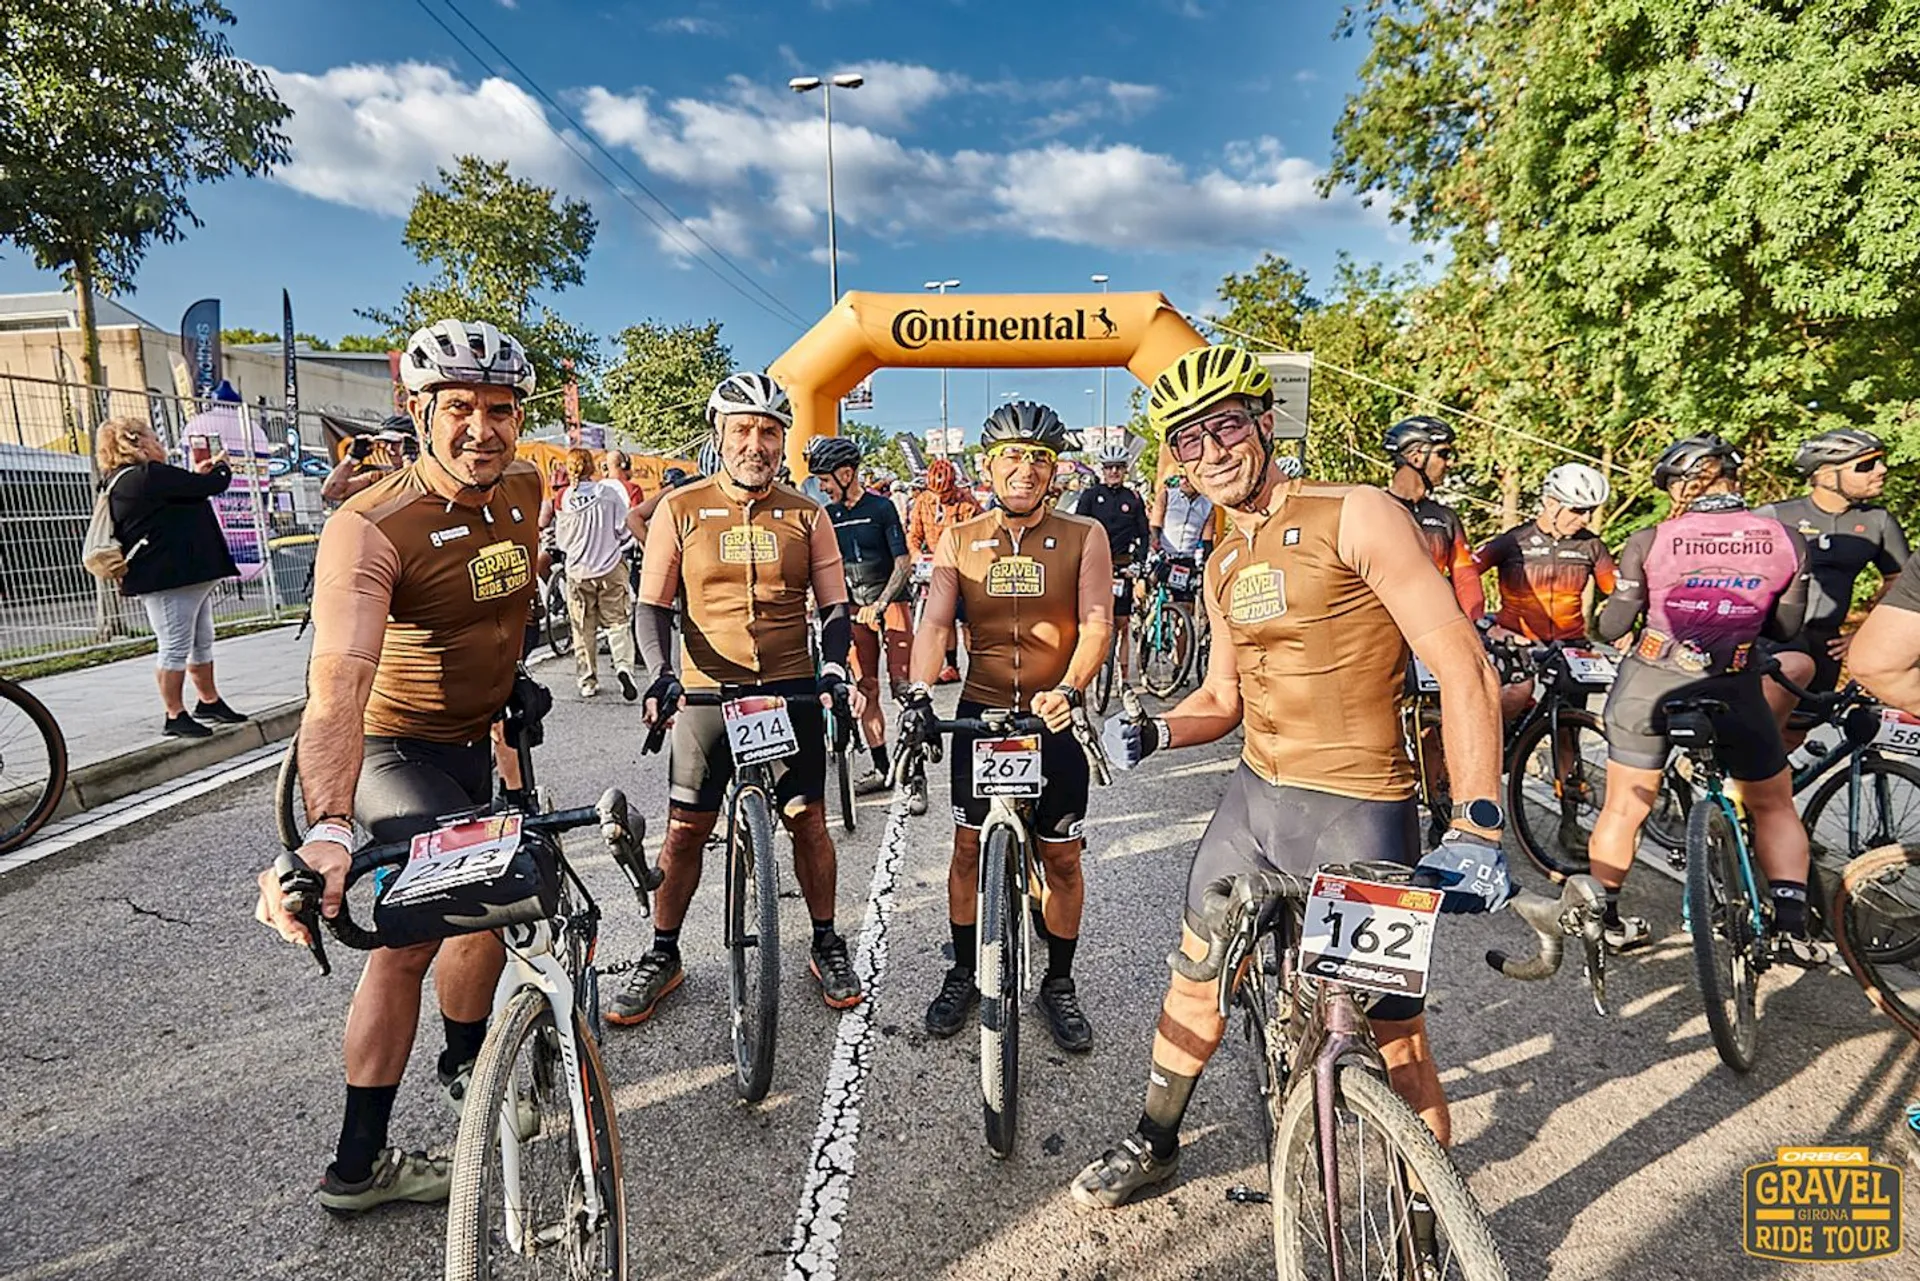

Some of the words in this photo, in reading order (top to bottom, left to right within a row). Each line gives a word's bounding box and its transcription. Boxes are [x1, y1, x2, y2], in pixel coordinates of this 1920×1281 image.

[892, 309, 1086, 349] Continental
[724, 532, 773, 546] GRAVEL
[1672, 537, 1774, 555] PINOCCHIO
[475, 550, 526, 578] GRAVEL
[991, 562, 1039, 578] GRAVEL
[478, 580, 503, 597] RIDE
[736, 717, 786, 747] 214
[982, 758, 1033, 778] 267
[409, 848, 500, 883] 243
[1457, 858, 1506, 886] FOX
[1321, 911, 1414, 960] 162
[1316, 961, 1408, 987] ORBEA
